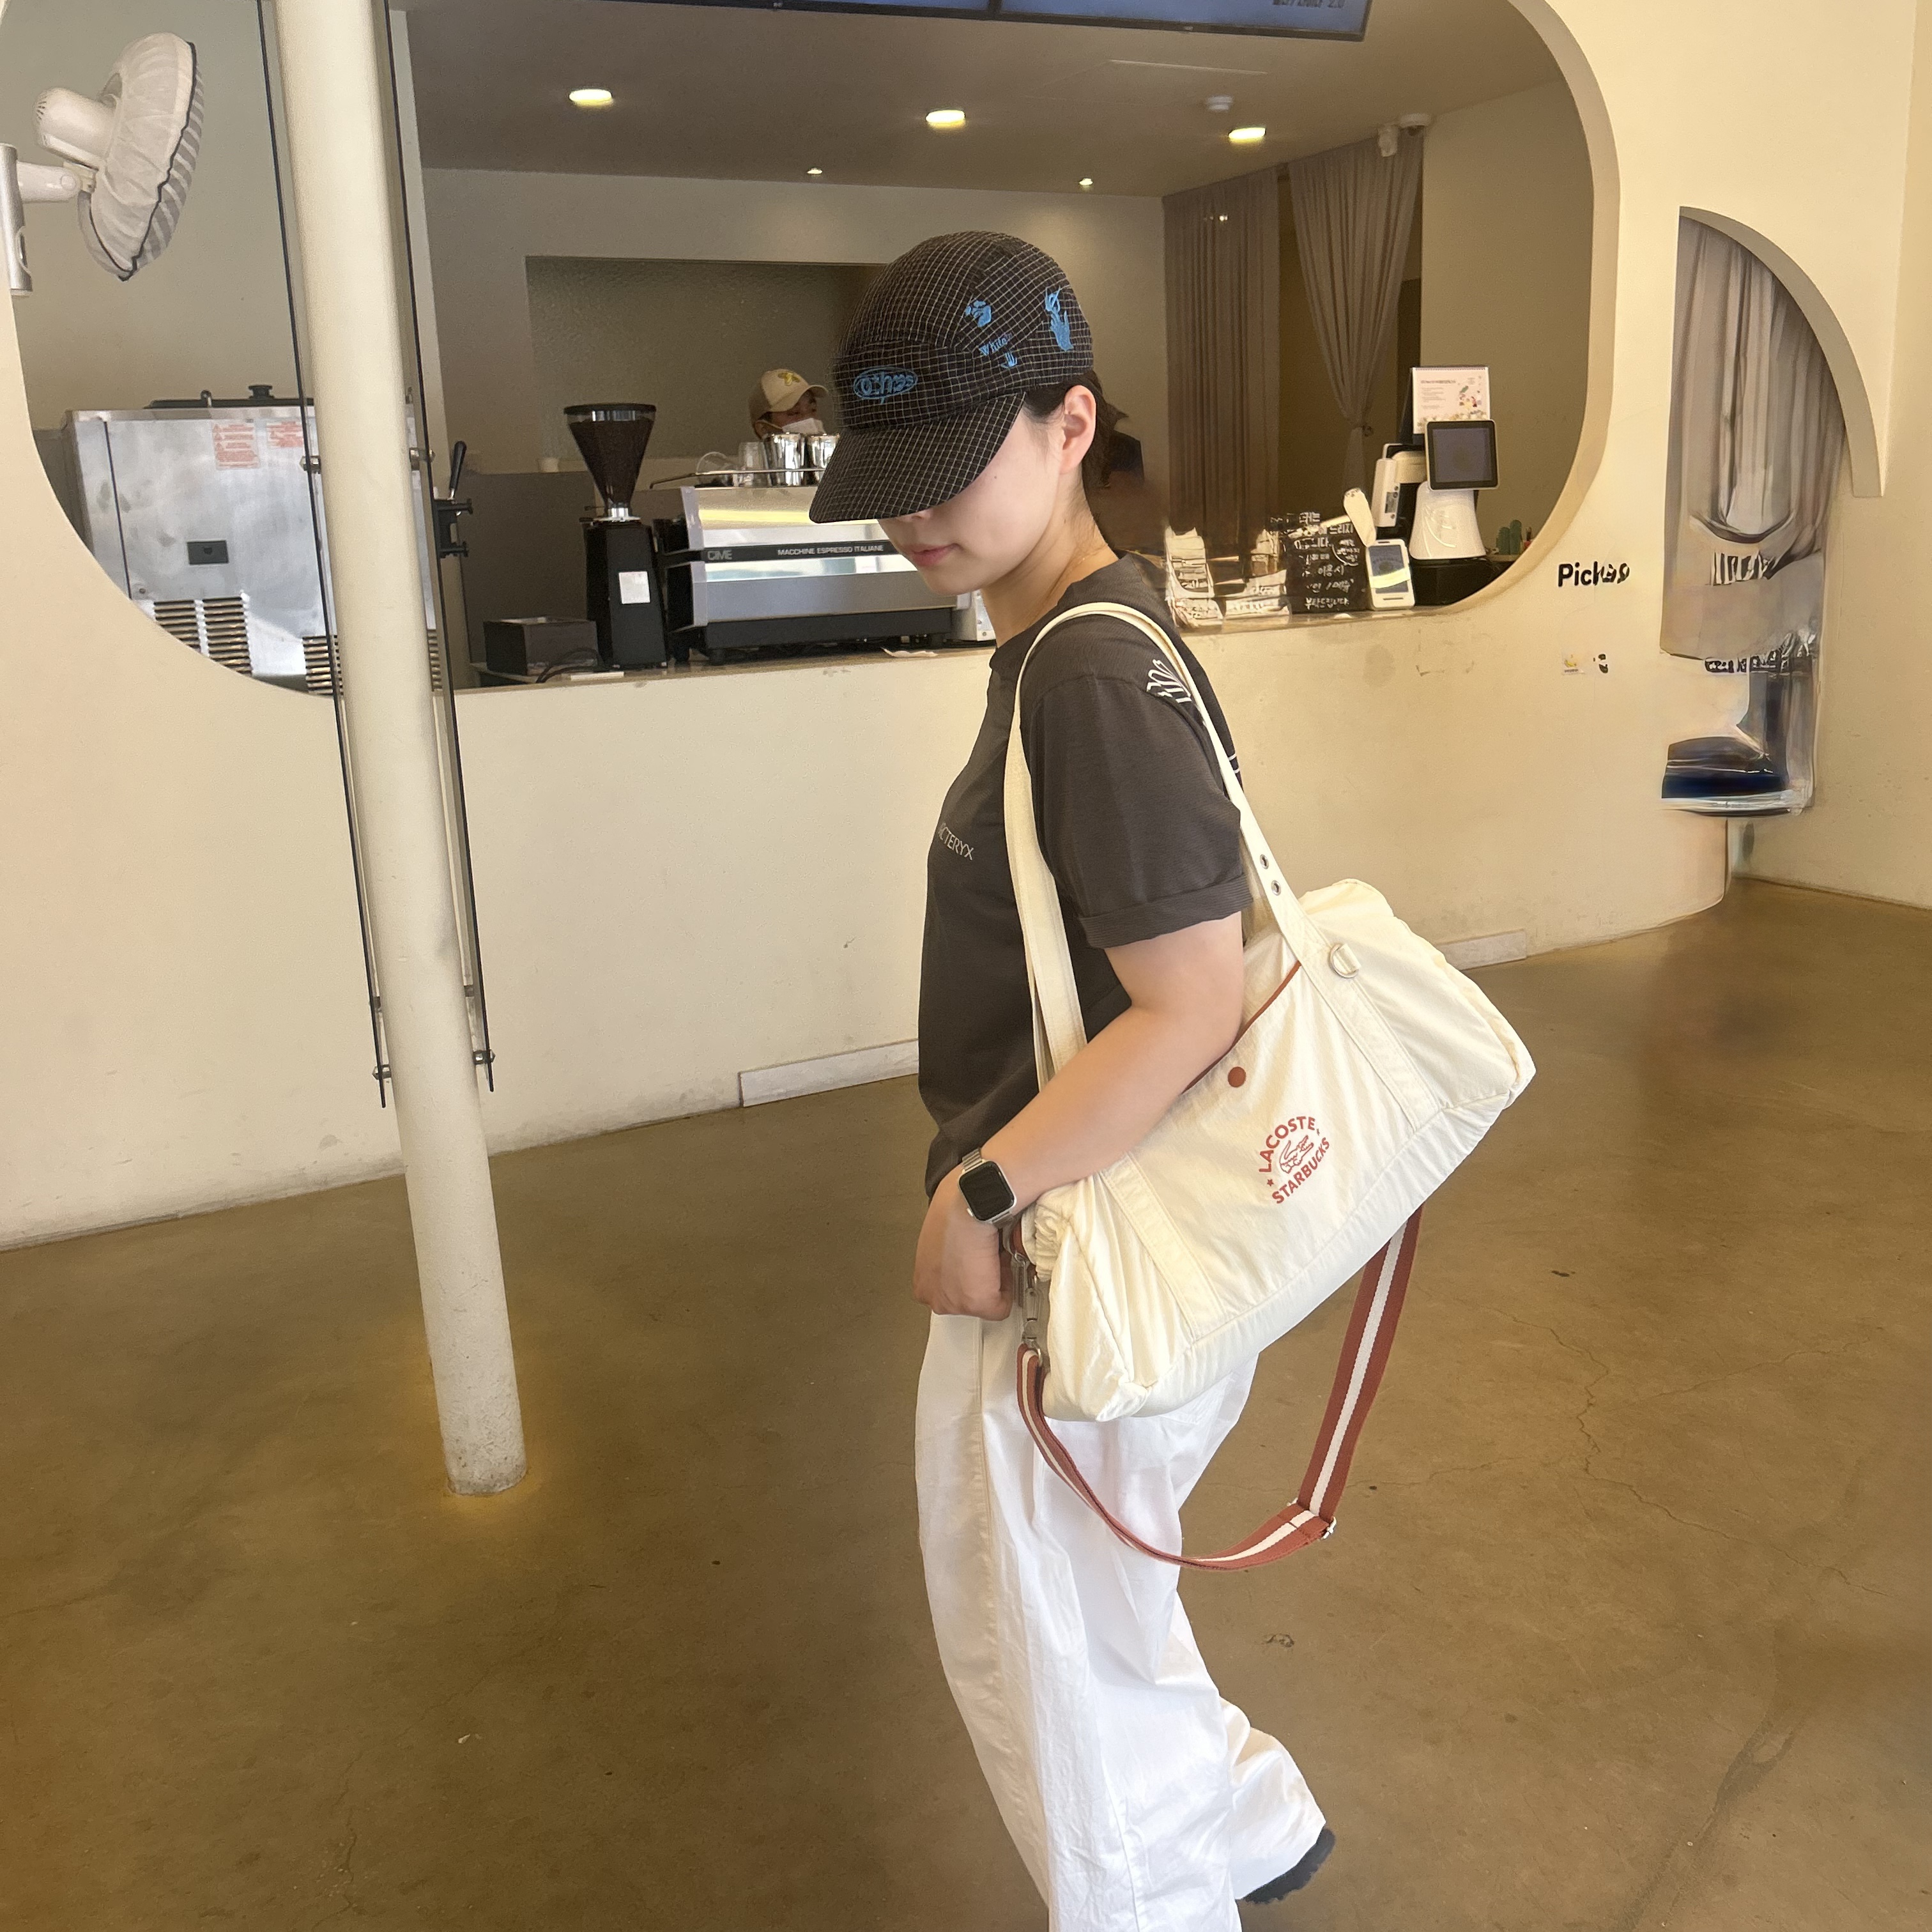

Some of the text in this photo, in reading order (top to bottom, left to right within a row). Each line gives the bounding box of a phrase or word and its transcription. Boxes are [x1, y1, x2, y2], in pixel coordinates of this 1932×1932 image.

[778, 548, 816, 556] MACCHINE
[816, 546, 853, 555] ESPRESSO
[1259, 1116, 1316, 1172] LACOSTE
[1272, 1137, 1330, 1204] STARBUCKS
